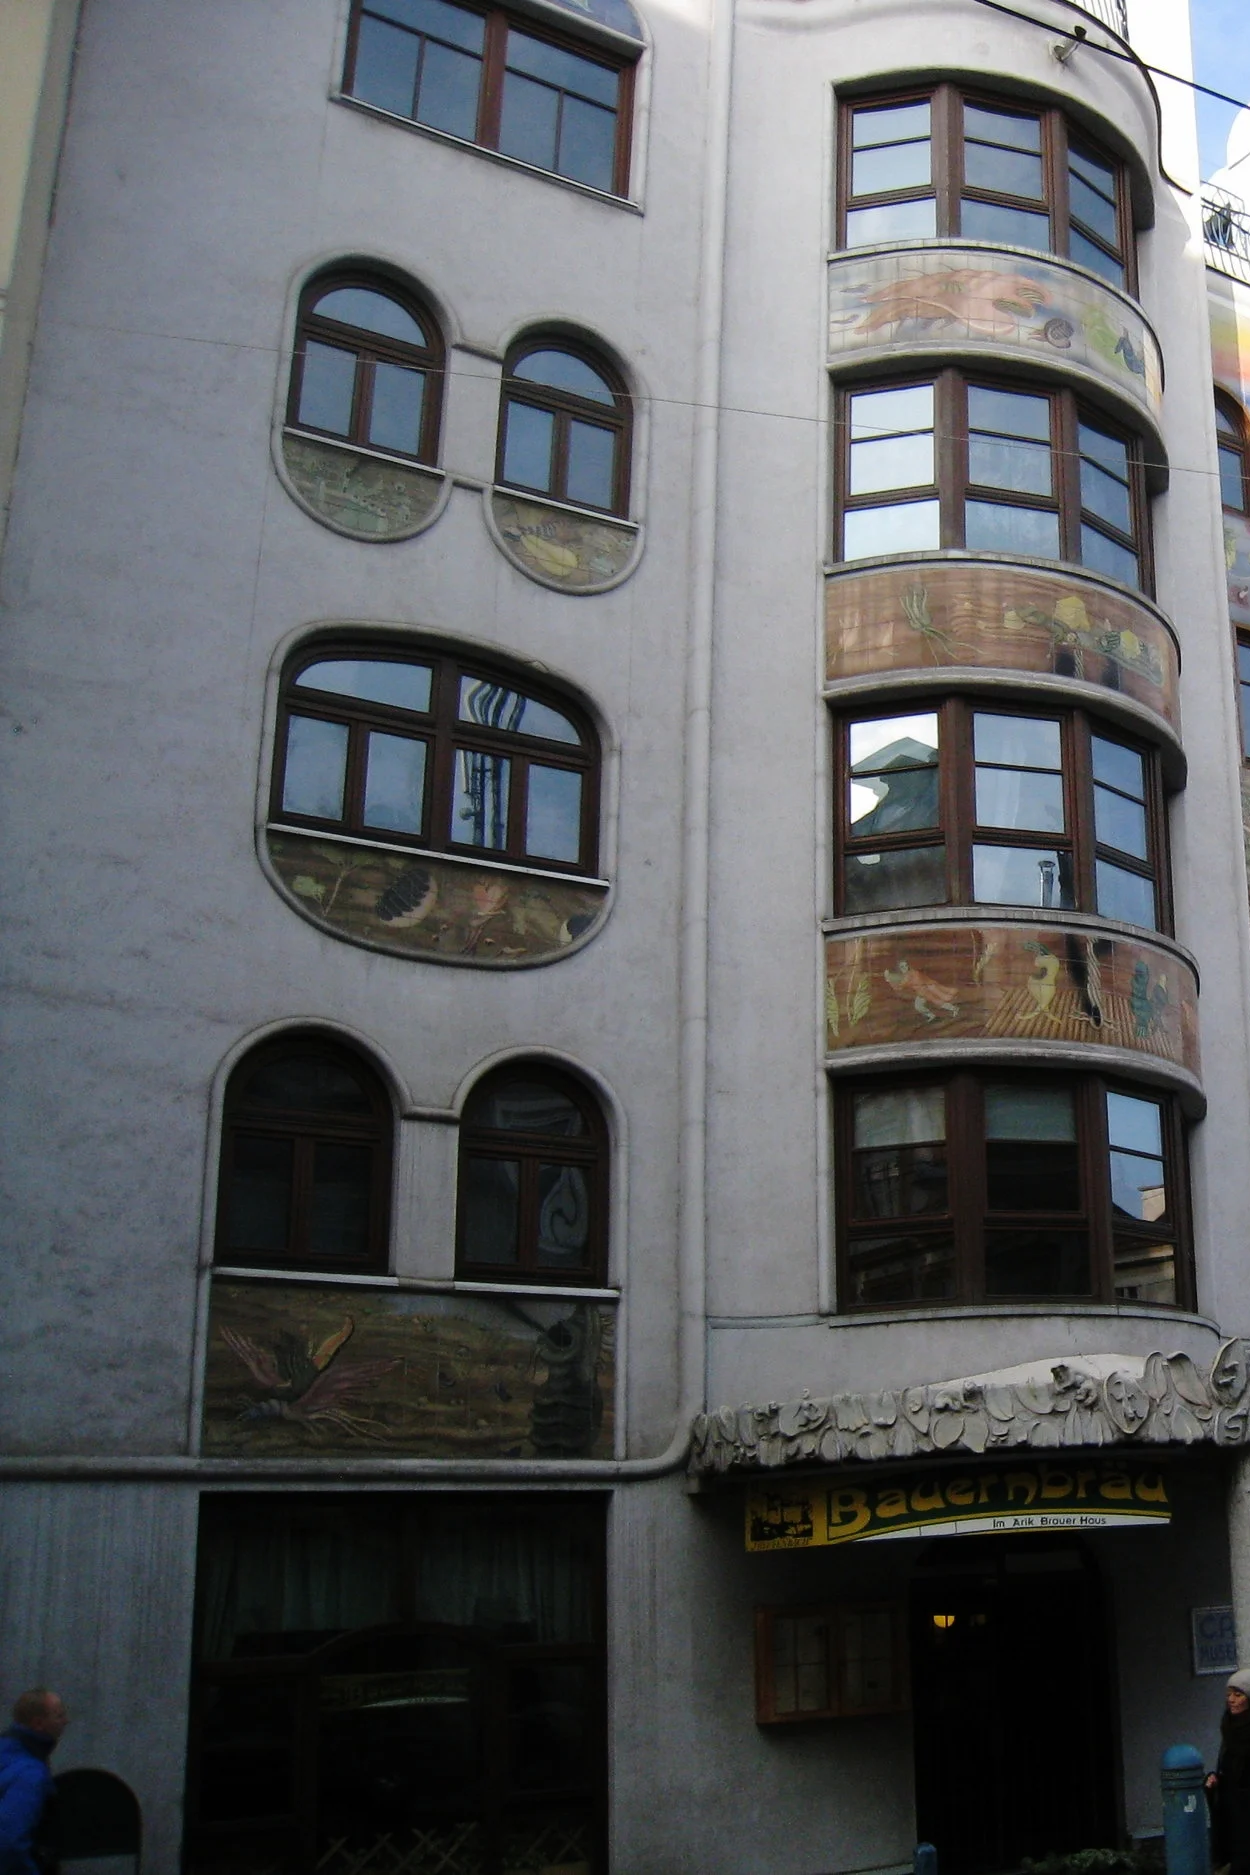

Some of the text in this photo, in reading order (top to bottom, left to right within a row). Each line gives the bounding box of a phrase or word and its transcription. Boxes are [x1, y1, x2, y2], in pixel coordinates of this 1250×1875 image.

[828, 1460, 1169, 1540] Bauernbräu
[1012, 1517, 1034, 1527] Arik
[1040, 1516, 1078, 1526] Brauer
[1080, 1515, 1107, 1525] Haus
